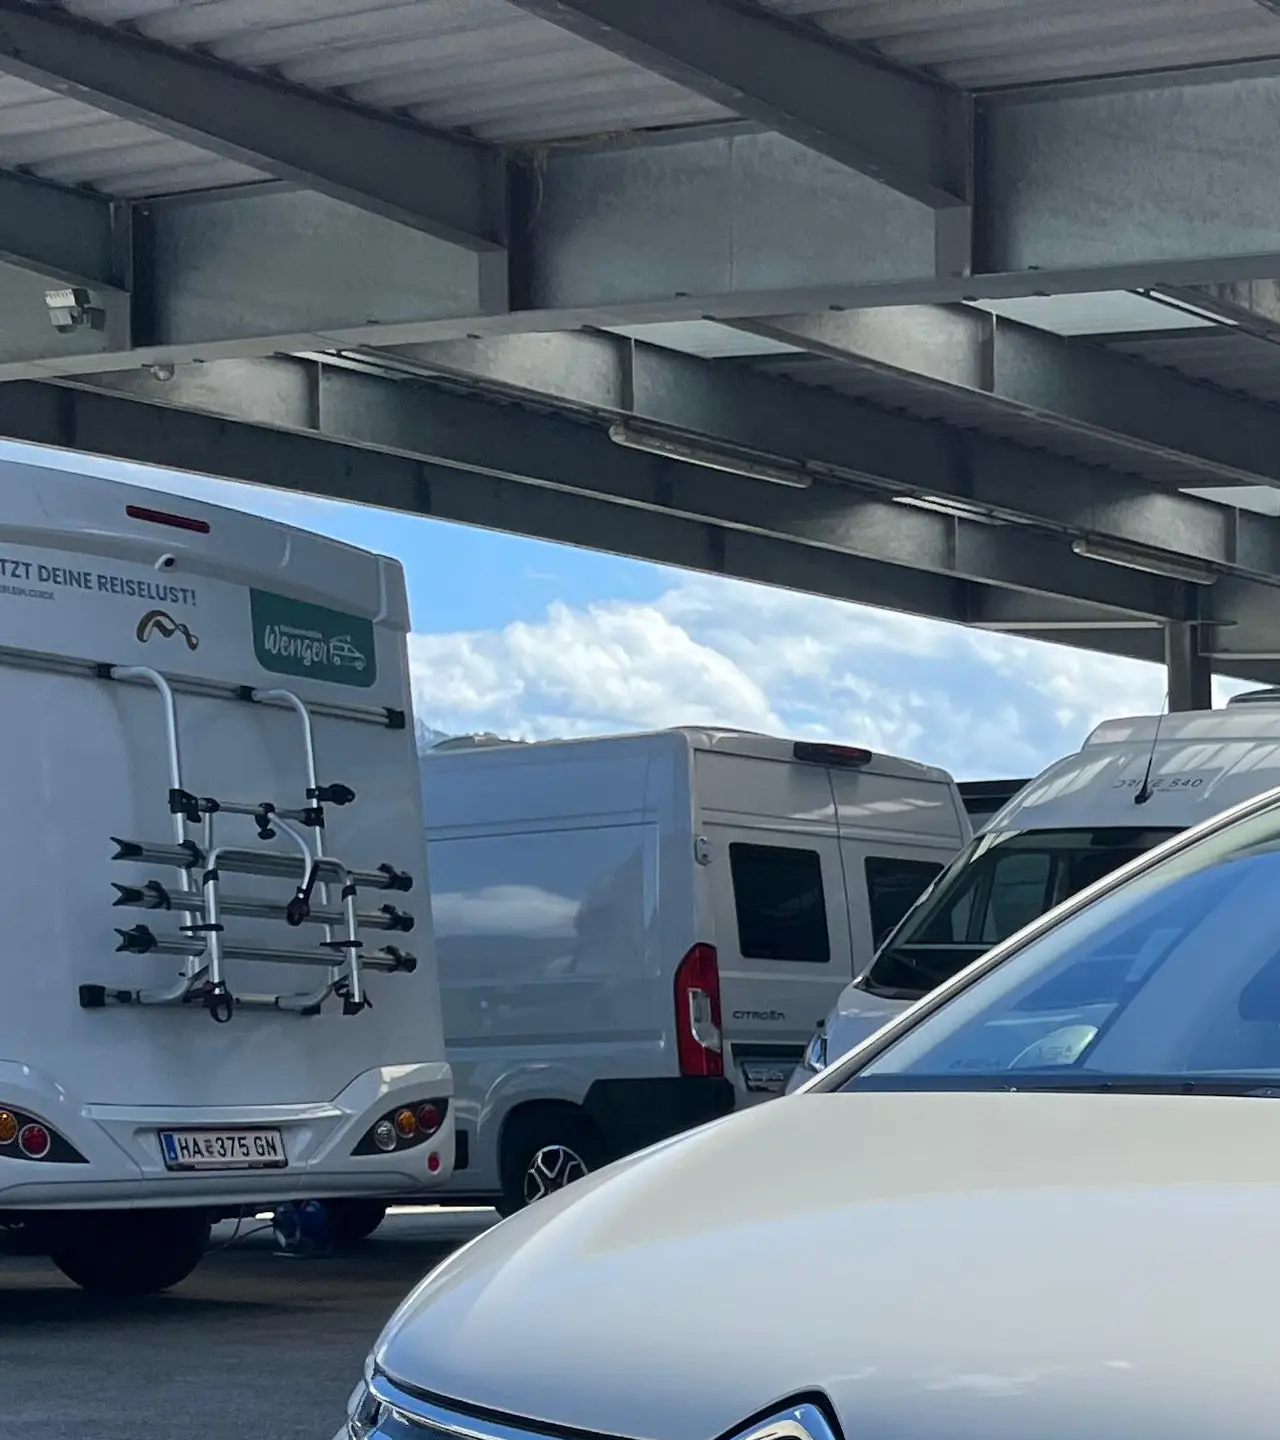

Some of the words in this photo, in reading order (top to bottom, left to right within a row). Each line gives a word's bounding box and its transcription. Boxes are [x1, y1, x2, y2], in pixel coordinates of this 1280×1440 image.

[37, 565, 93, 590] DEINE
[97, 575, 197, 606] REISELUST!
[264, 625, 328, 666] Wenger
[178, 1137, 204, 1158] HA
[215, 1137, 250, 1157] 375
[254, 1136, 277, 1156] GN
